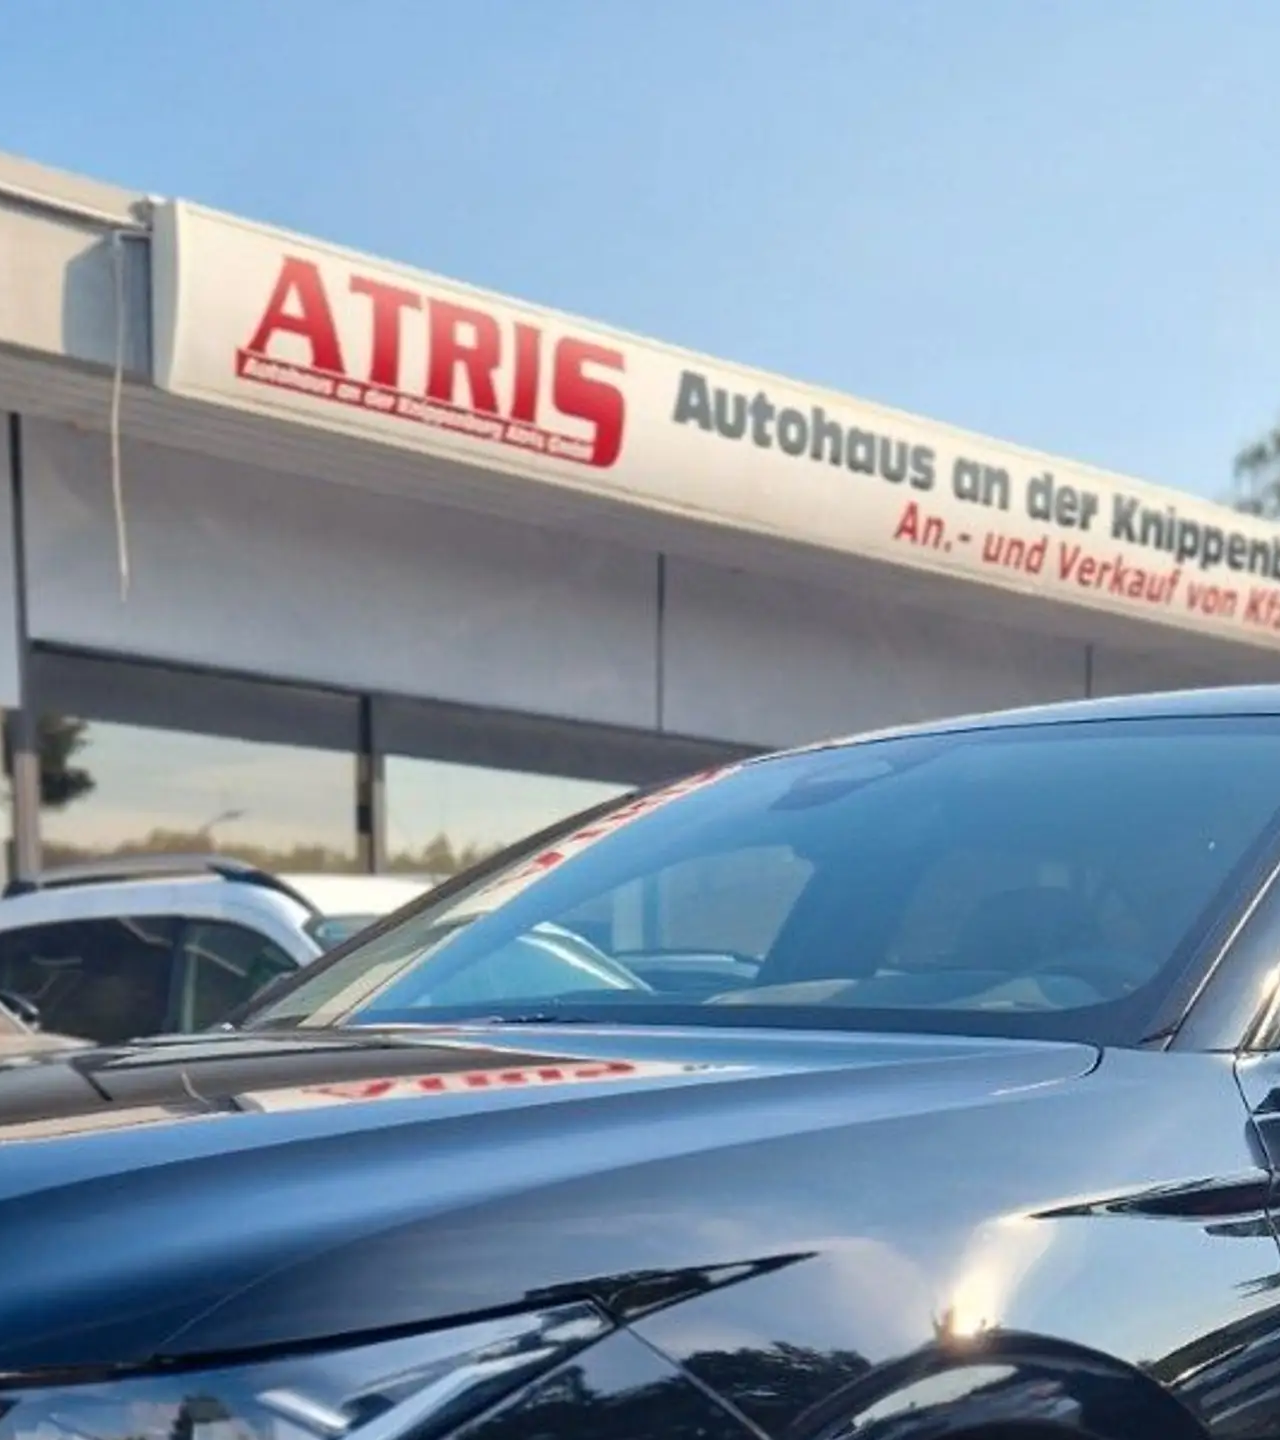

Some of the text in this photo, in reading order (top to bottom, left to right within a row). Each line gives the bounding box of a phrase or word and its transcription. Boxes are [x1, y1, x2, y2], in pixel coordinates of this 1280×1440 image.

[237, 254, 626, 467] ATRIS
[673, 369, 935, 491] Autohaus
[953, 456, 1010, 510] an
[1026, 471, 1098, 530] der
[894, 501, 972, 552] An.-
[981, 531, 1049, 575] und
[1057, 541, 1182, 605] Verkauf
[1186, 580, 1239, 616] von
